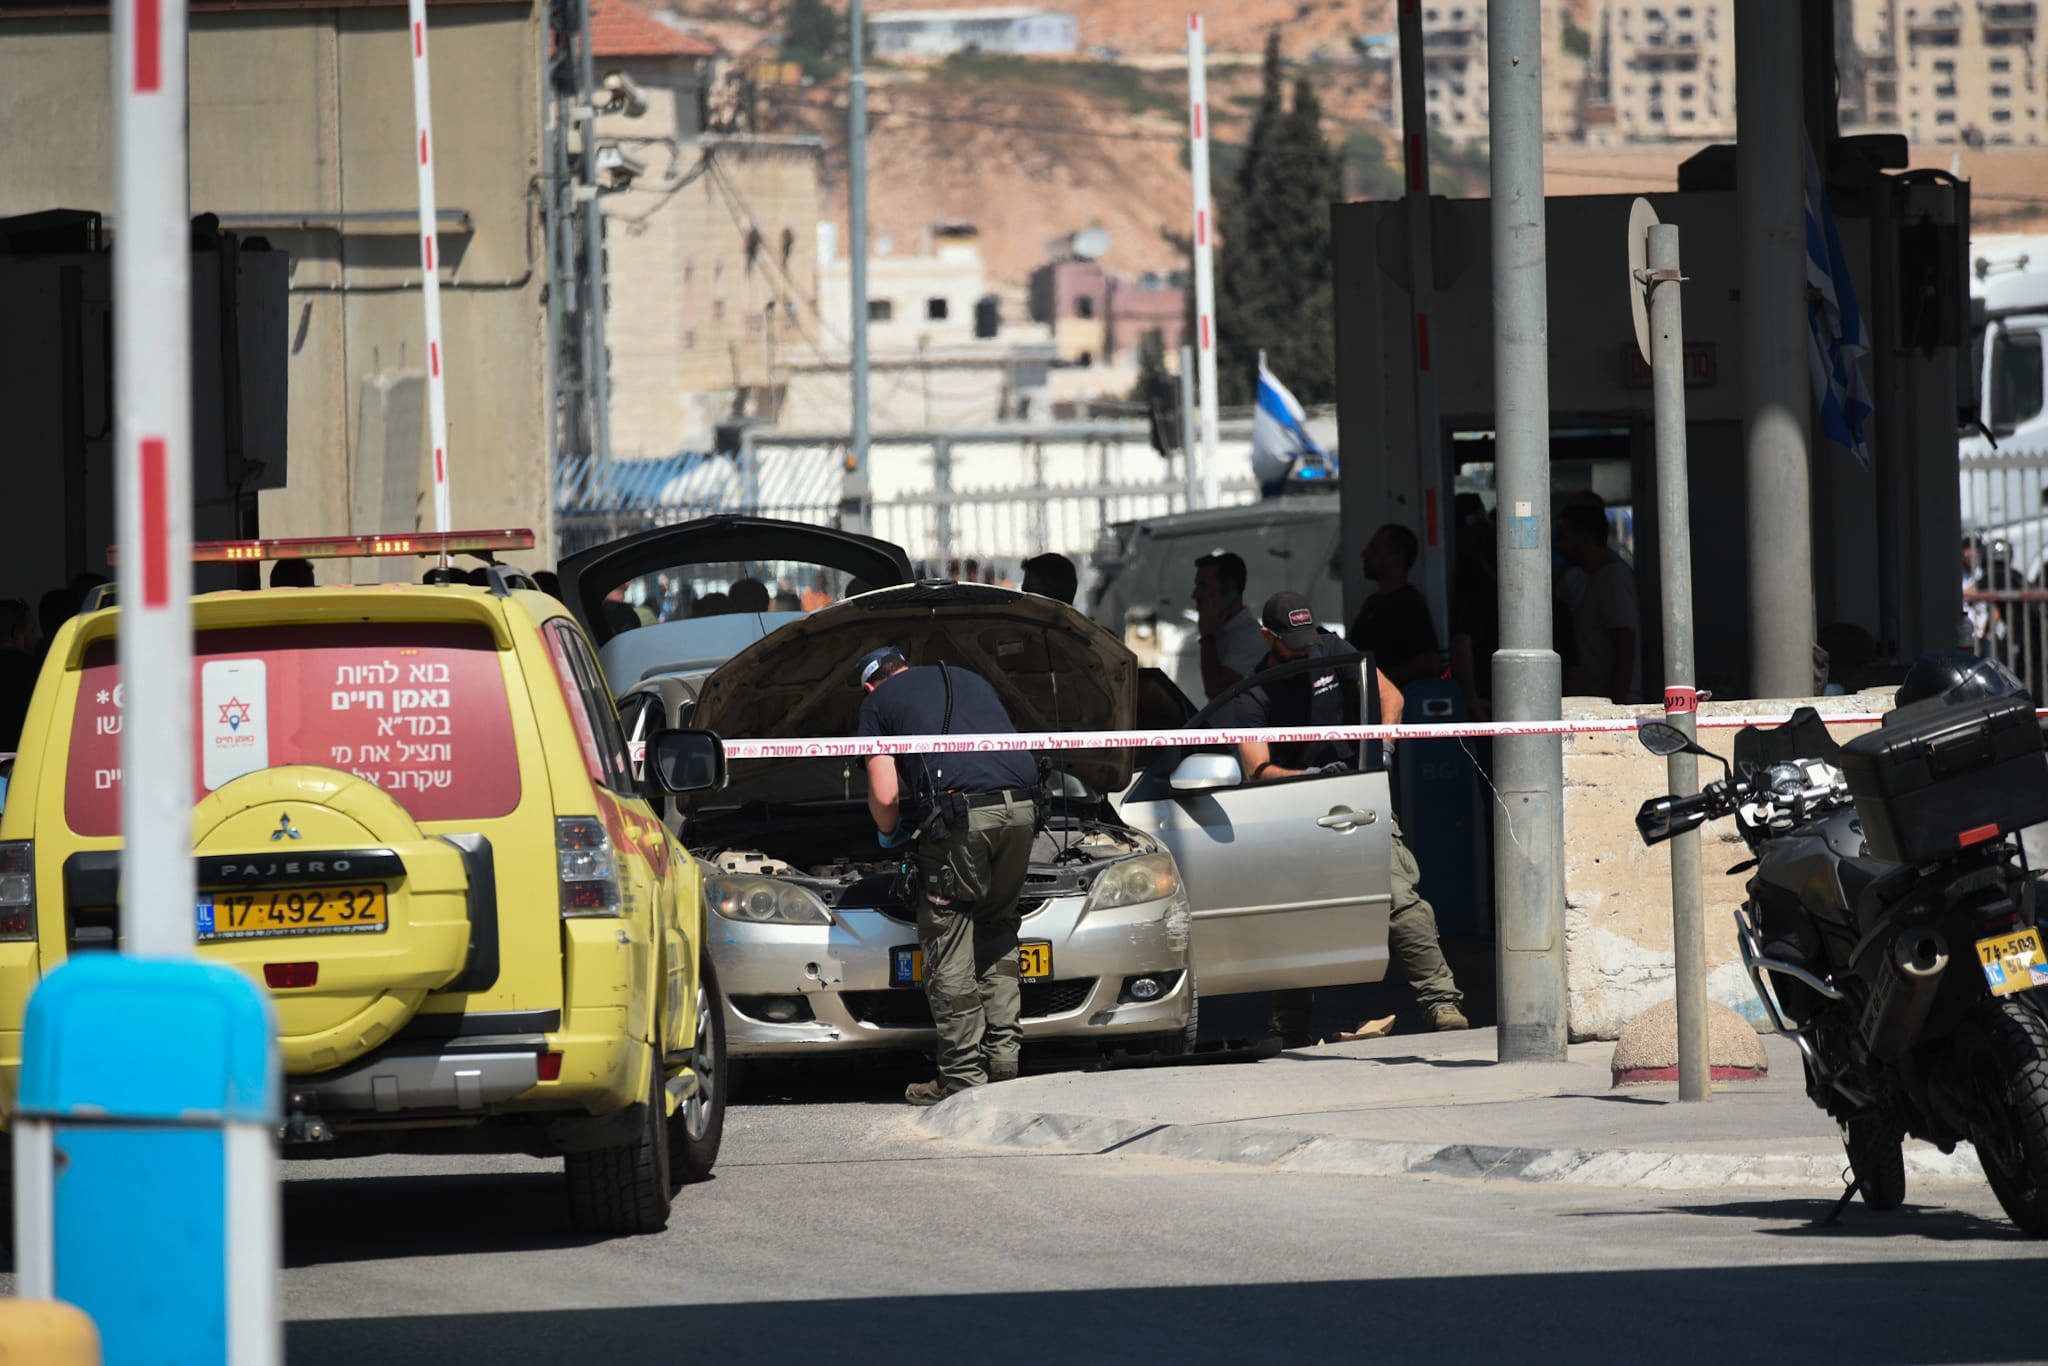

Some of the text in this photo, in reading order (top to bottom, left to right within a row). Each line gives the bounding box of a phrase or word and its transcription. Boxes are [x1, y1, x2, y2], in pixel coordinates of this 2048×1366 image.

[336, 660, 450, 685] בוא להיות
[331, 689, 450, 713] נאמן חיים
[858, 743, 873, 755] אין
[877, 740, 912, 754] ישראל
[932, 741, 975, 752] משטרת
[997, 740, 1028, 751] מעבר
[1031, 739, 1045, 750] אין
[1048, 736, 1084, 749] ישראל
[1104, 737, 1148, 748] משטרת
[331, 740, 451, 763] ותציל את מי
[761, 745, 803, 756] משטרת
[825, 744, 855, 756] מעבר
[95, 769, 123, 789] יים
[387, 770, 451, 792] שקרוב
[221, 861, 351, 876] PAJERO
